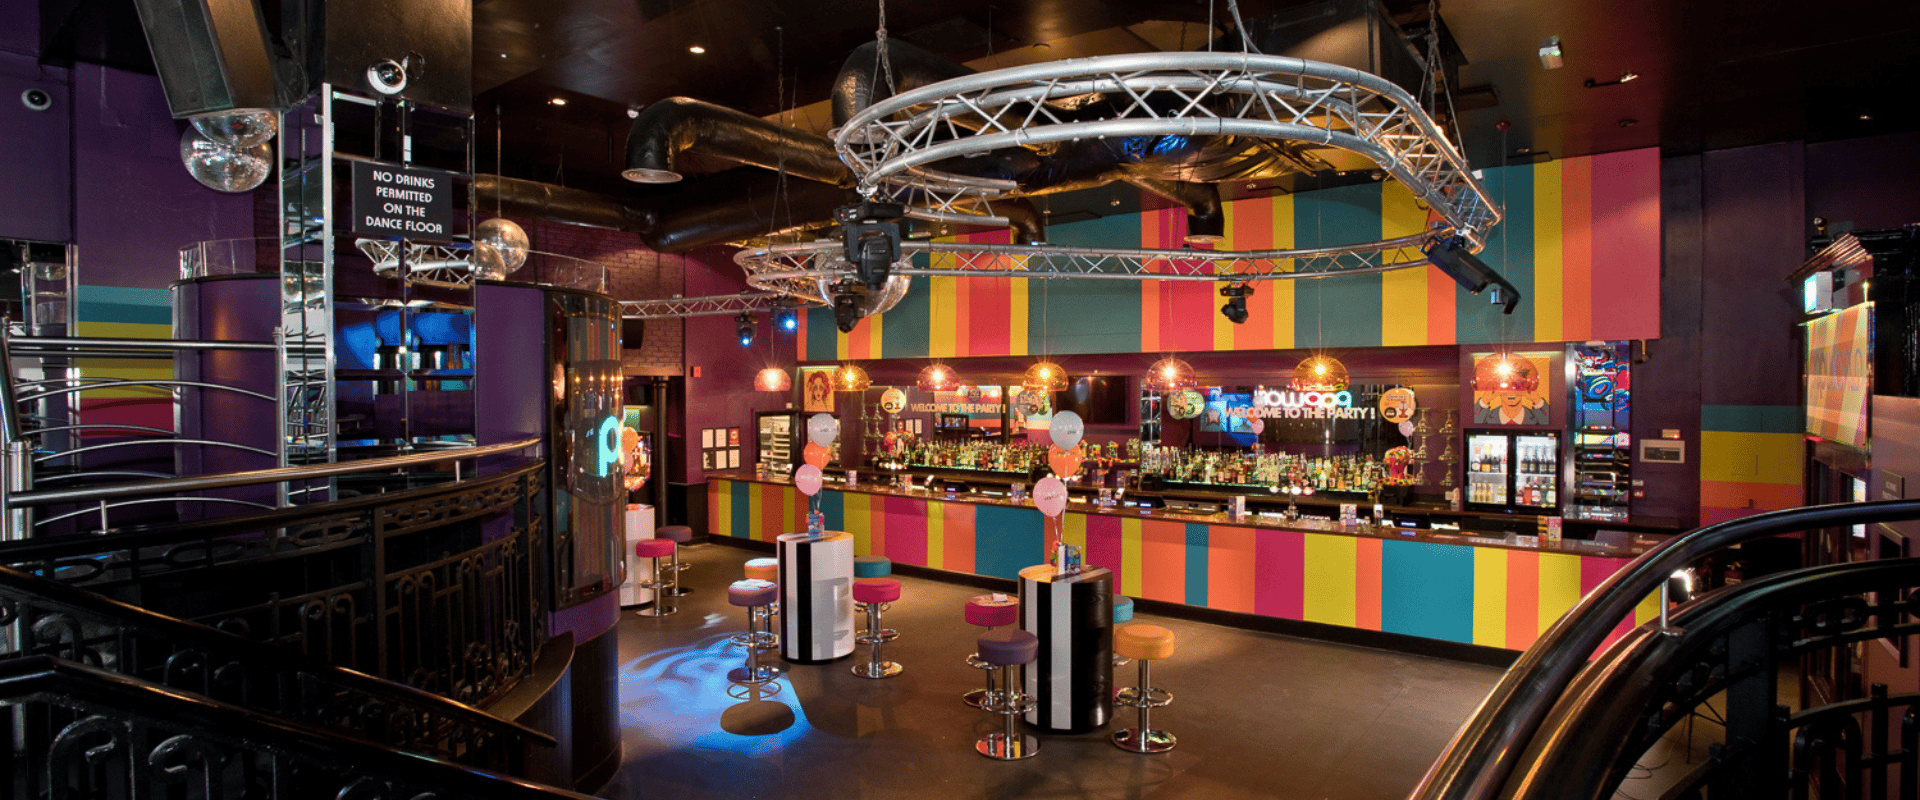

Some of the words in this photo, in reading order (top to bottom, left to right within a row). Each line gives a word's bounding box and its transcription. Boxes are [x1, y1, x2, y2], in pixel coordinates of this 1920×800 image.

[373, 171, 393, 183] NO
[396, 174, 435, 189] DRINKS
[376, 186, 433, 203] PERMITTED
[383, 203, 403, 215] ON
[405, 205, 426, 218] THE
[365, 216, 403, 230] DANCE
[405, 220, 443, 235] FLOOR
[910, 403, 948, 412] WELCOME
[948, 403, 959, 413] TO
[959, 403, 975, 413] THE
[975, 403, 1001, 413] PARTY
[1225, 407, 1282, 418] WELCOME
[1283, 407, 1301, 418] TO
[1302, 407, 1325, 418] THE
[1327, 407, 1368, 419] PARTY
[599, 416, 624, 477] p
